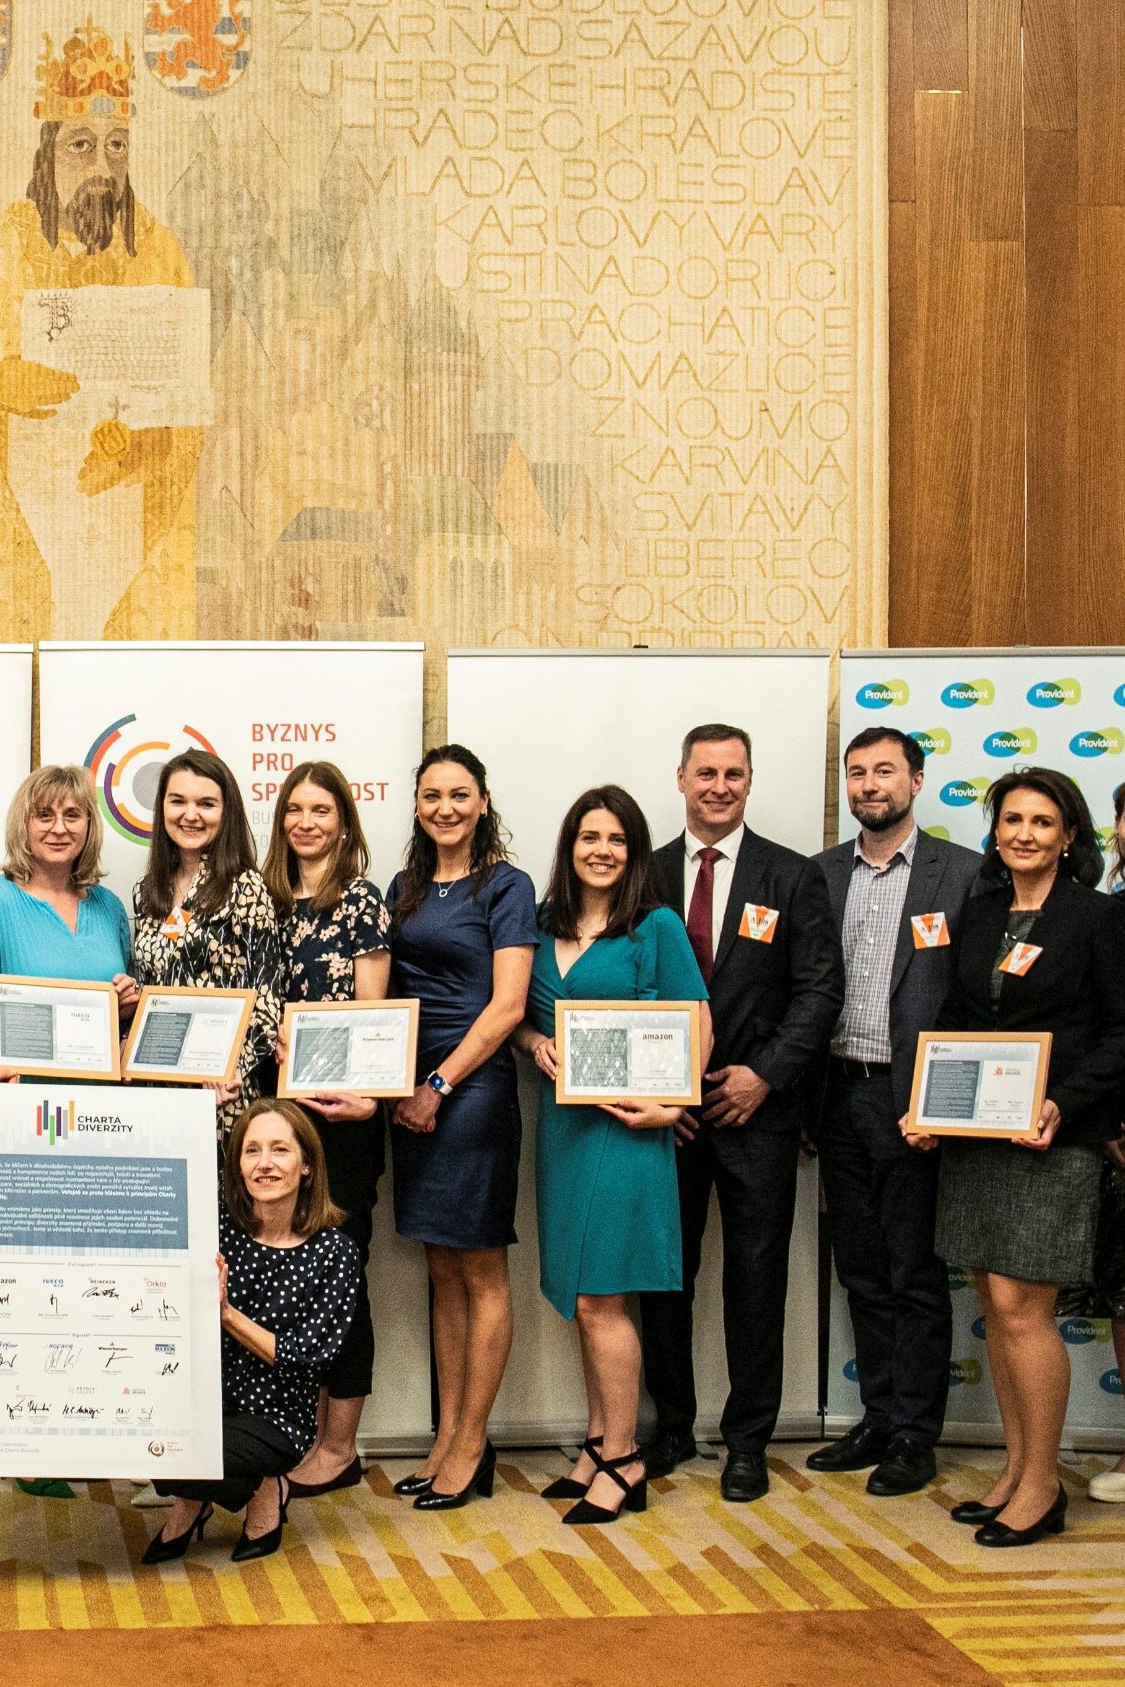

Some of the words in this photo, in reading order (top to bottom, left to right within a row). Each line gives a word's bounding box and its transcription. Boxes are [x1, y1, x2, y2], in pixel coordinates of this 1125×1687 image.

[449, 15, 563, 57] NAD
[340, 107, 584, 152] HRADEC
[562, 158, 852, 207] BOLESLAV
[434, 203, 697, 249] KARLOVY
[704, 210, 852, 254] VARY
[555, 252, 670, 297] NAD
[497, 300, 852, 348] PRACHATICE
[633, 490, 850, 533] SVITAVY
[624, 537, 852, 579] LIBEREC
[576, 583, 849, 624] SOKOLOV
[865, 689, 903, 700] Provident
[950, 688, 989, 700] Provident
[1036, 688, 1075, 700] Provident
[251, 723, 336, 742] BYZNYS
[992, 738, 1031, 749] Provident
[1079, 738, 1118, 749] Provident
[252, 752, 294, 771] PRO
[948, 787, 987, 798] Providen
[642, 1032, 674, 1041] amazon
[77, 1115, 122, 1124] CHARTA
[77, 1123, 134, 1133] DIVERZITY
[146, 1280, 167, 1288] Orkla
